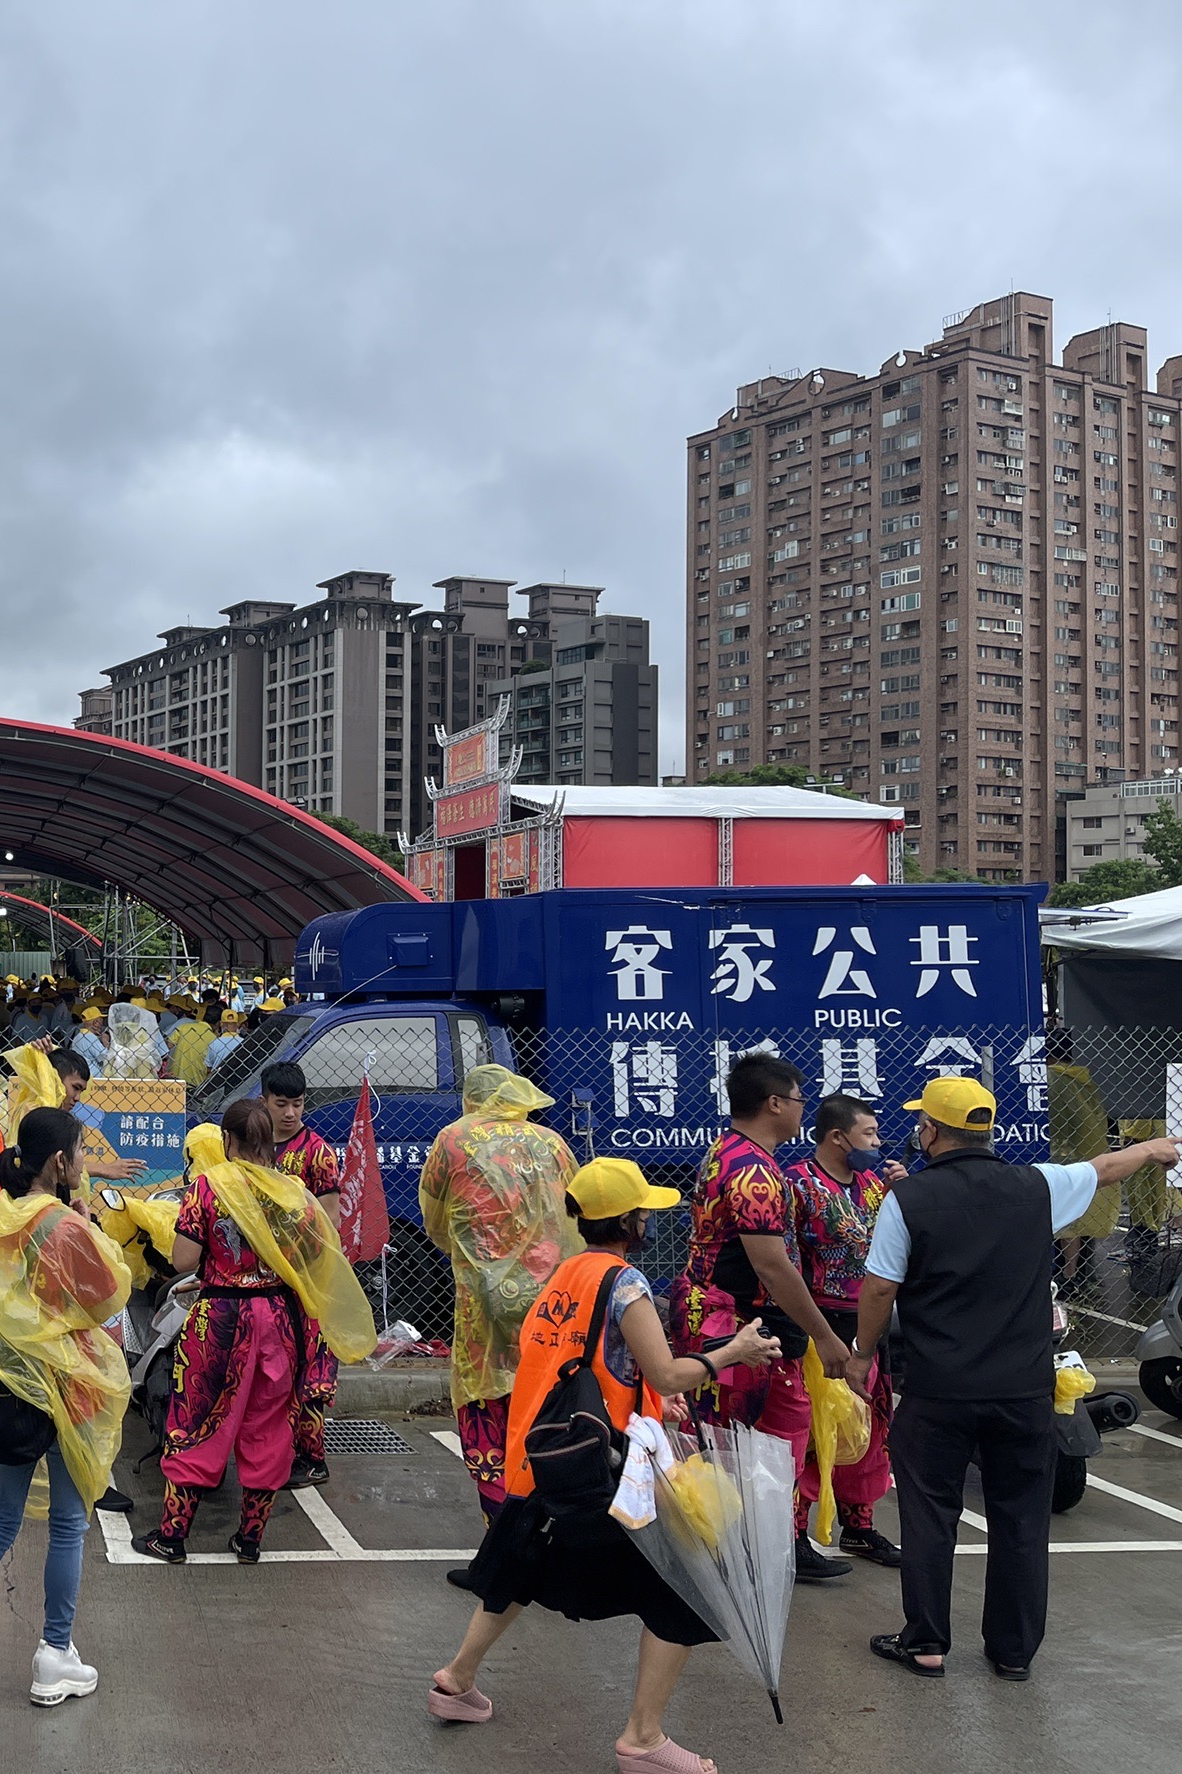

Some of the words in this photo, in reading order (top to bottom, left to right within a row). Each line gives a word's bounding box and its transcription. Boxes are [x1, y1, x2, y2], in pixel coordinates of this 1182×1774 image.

[605, 923, 980, 1002] 客家公共
[606, 1011, 694, 1031] HAKKA
[814, 1008, 902, 1028] PUBLIC
[120, 1115, 165, 1131] 請配合
[120, 1132, 181, 1149] 防疫措施
